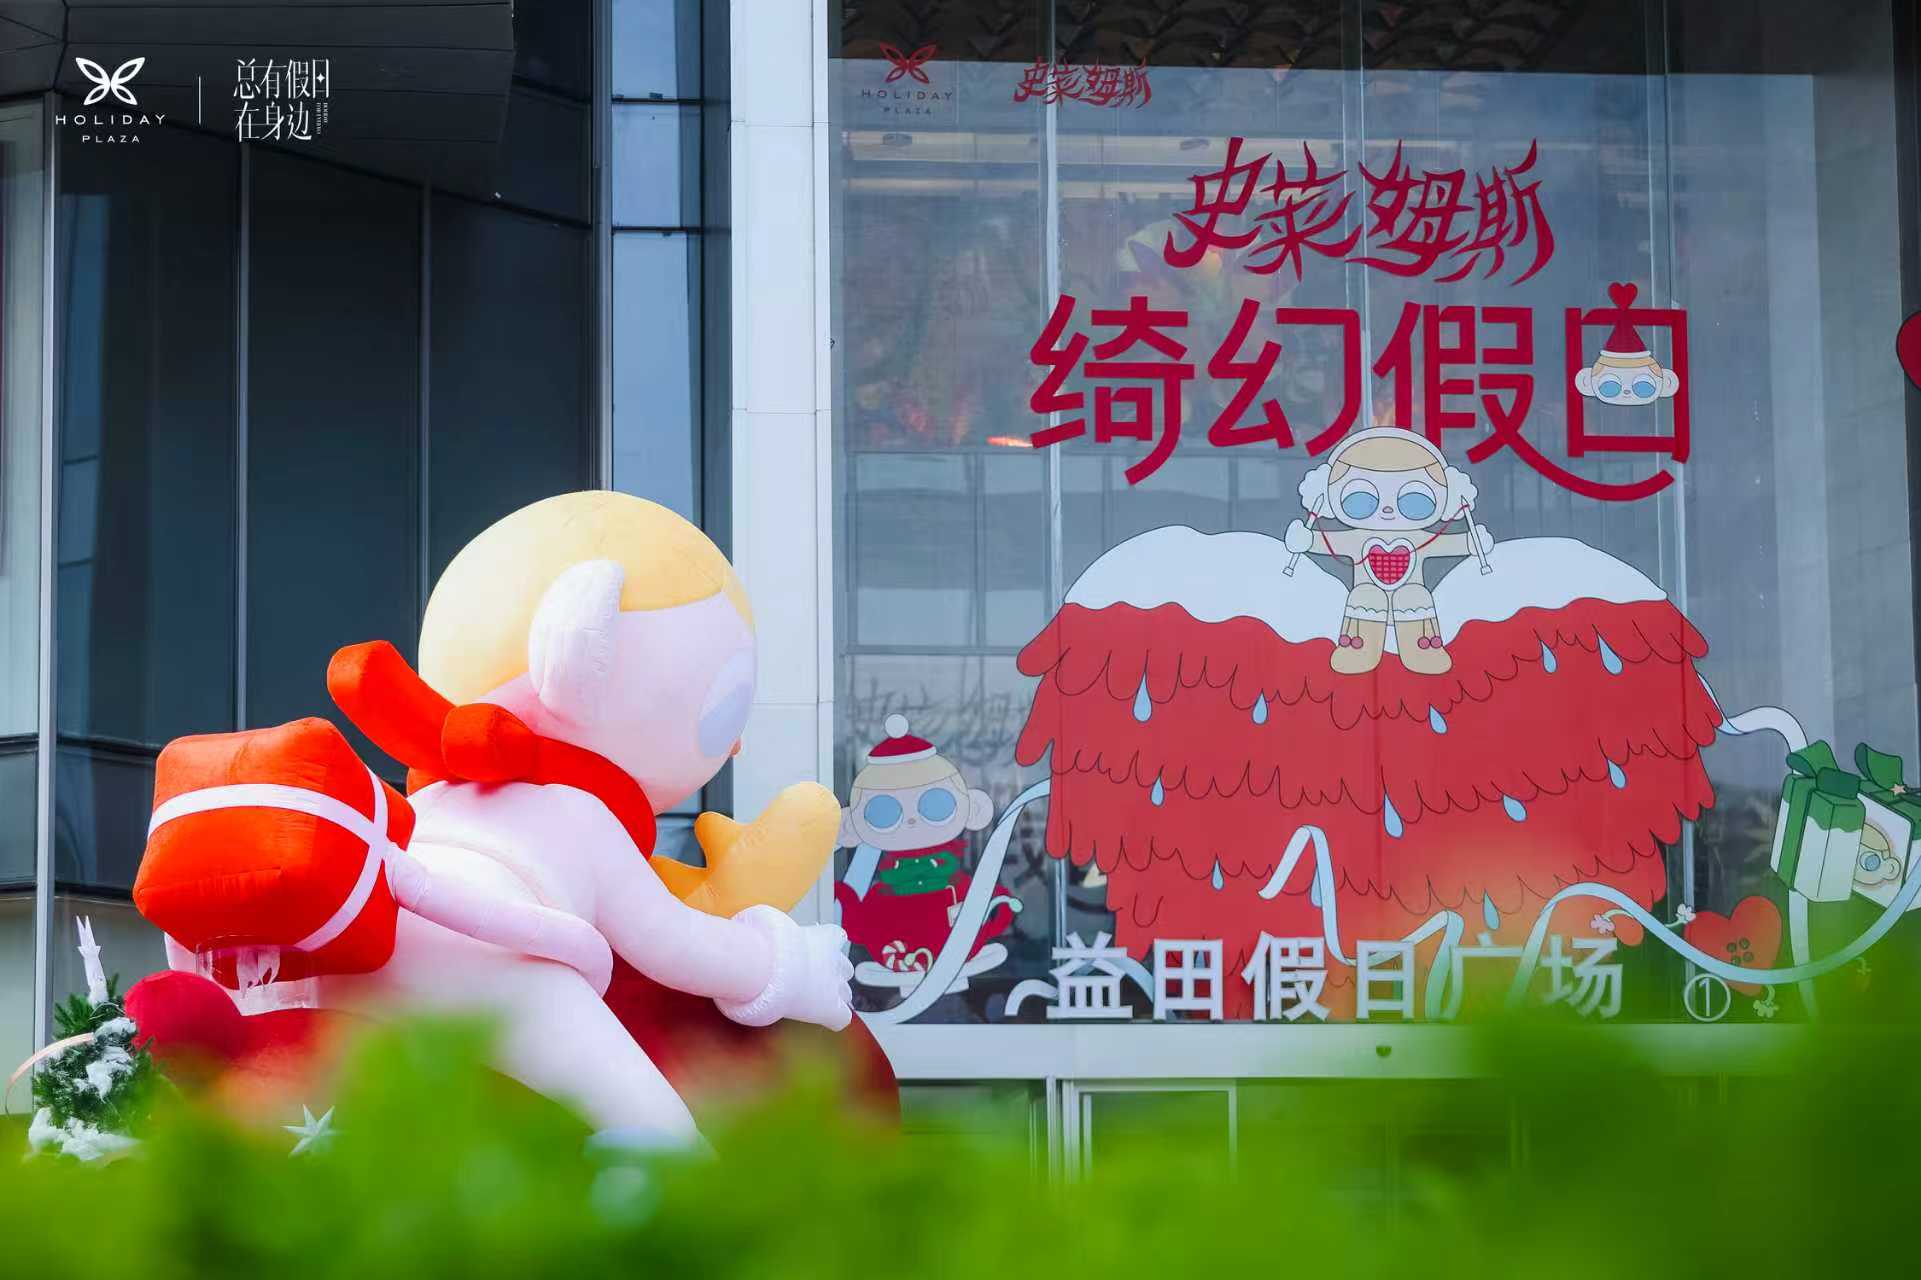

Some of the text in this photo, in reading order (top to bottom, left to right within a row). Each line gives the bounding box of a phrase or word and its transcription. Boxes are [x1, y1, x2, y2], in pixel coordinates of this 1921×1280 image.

[861, 88, 953, 101] HOLIDAY
[883, 106, 932, 115] PLAZA
[1013, 56, 1153, 109] 史莱姆斯
[1163, 137, 1555, 285] 史莱姆斯
[1029, 294, 1690, 502] 绮幻假日
[1046, 931, 1623, 1021] 益田假日广场
